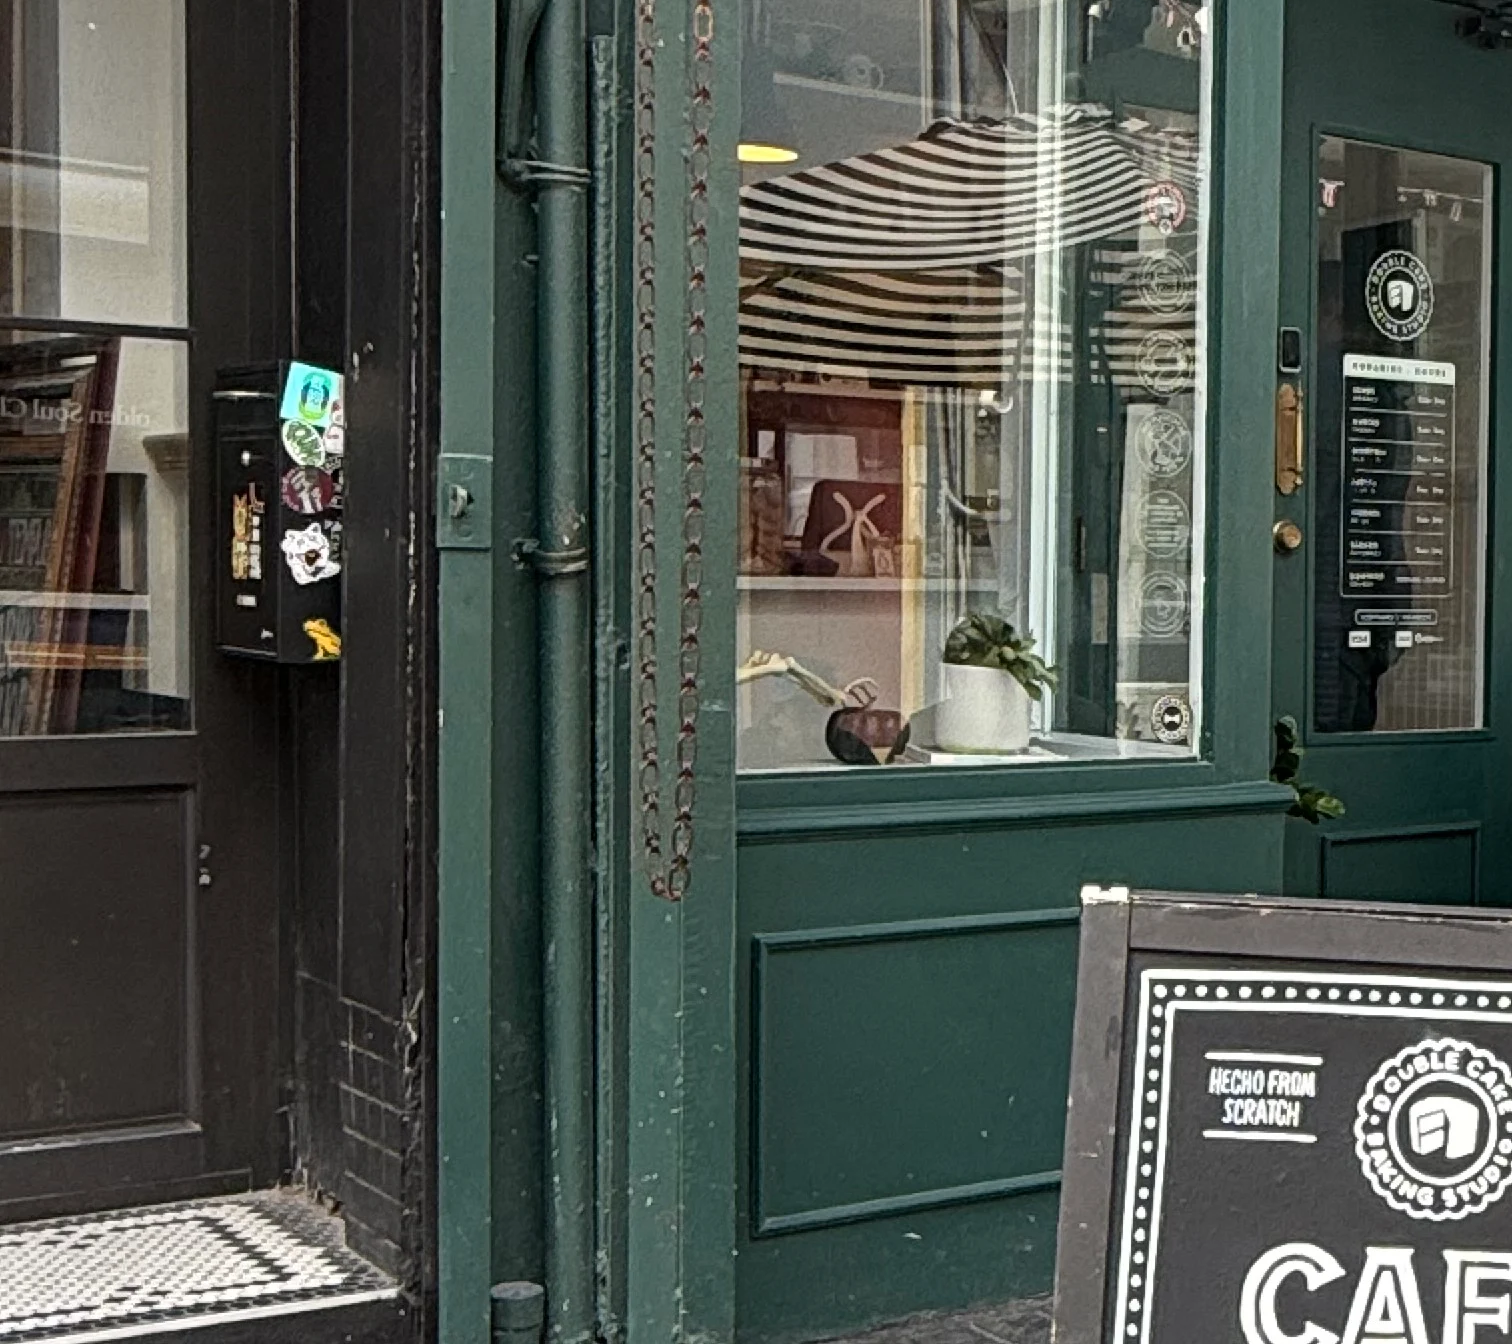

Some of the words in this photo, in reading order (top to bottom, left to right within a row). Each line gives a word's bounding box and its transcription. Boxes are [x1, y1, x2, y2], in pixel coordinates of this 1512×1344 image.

[1208, 1066, 1265, 1096] HECHO
[1266, 1068, 1316, 1098] FROM
[1372, 1050, 1461, 1113] DOUBLE
[1220, 1097, 1301, 1128] SCRATCH
[1365, 1131, 1435, 1207] BAKING
